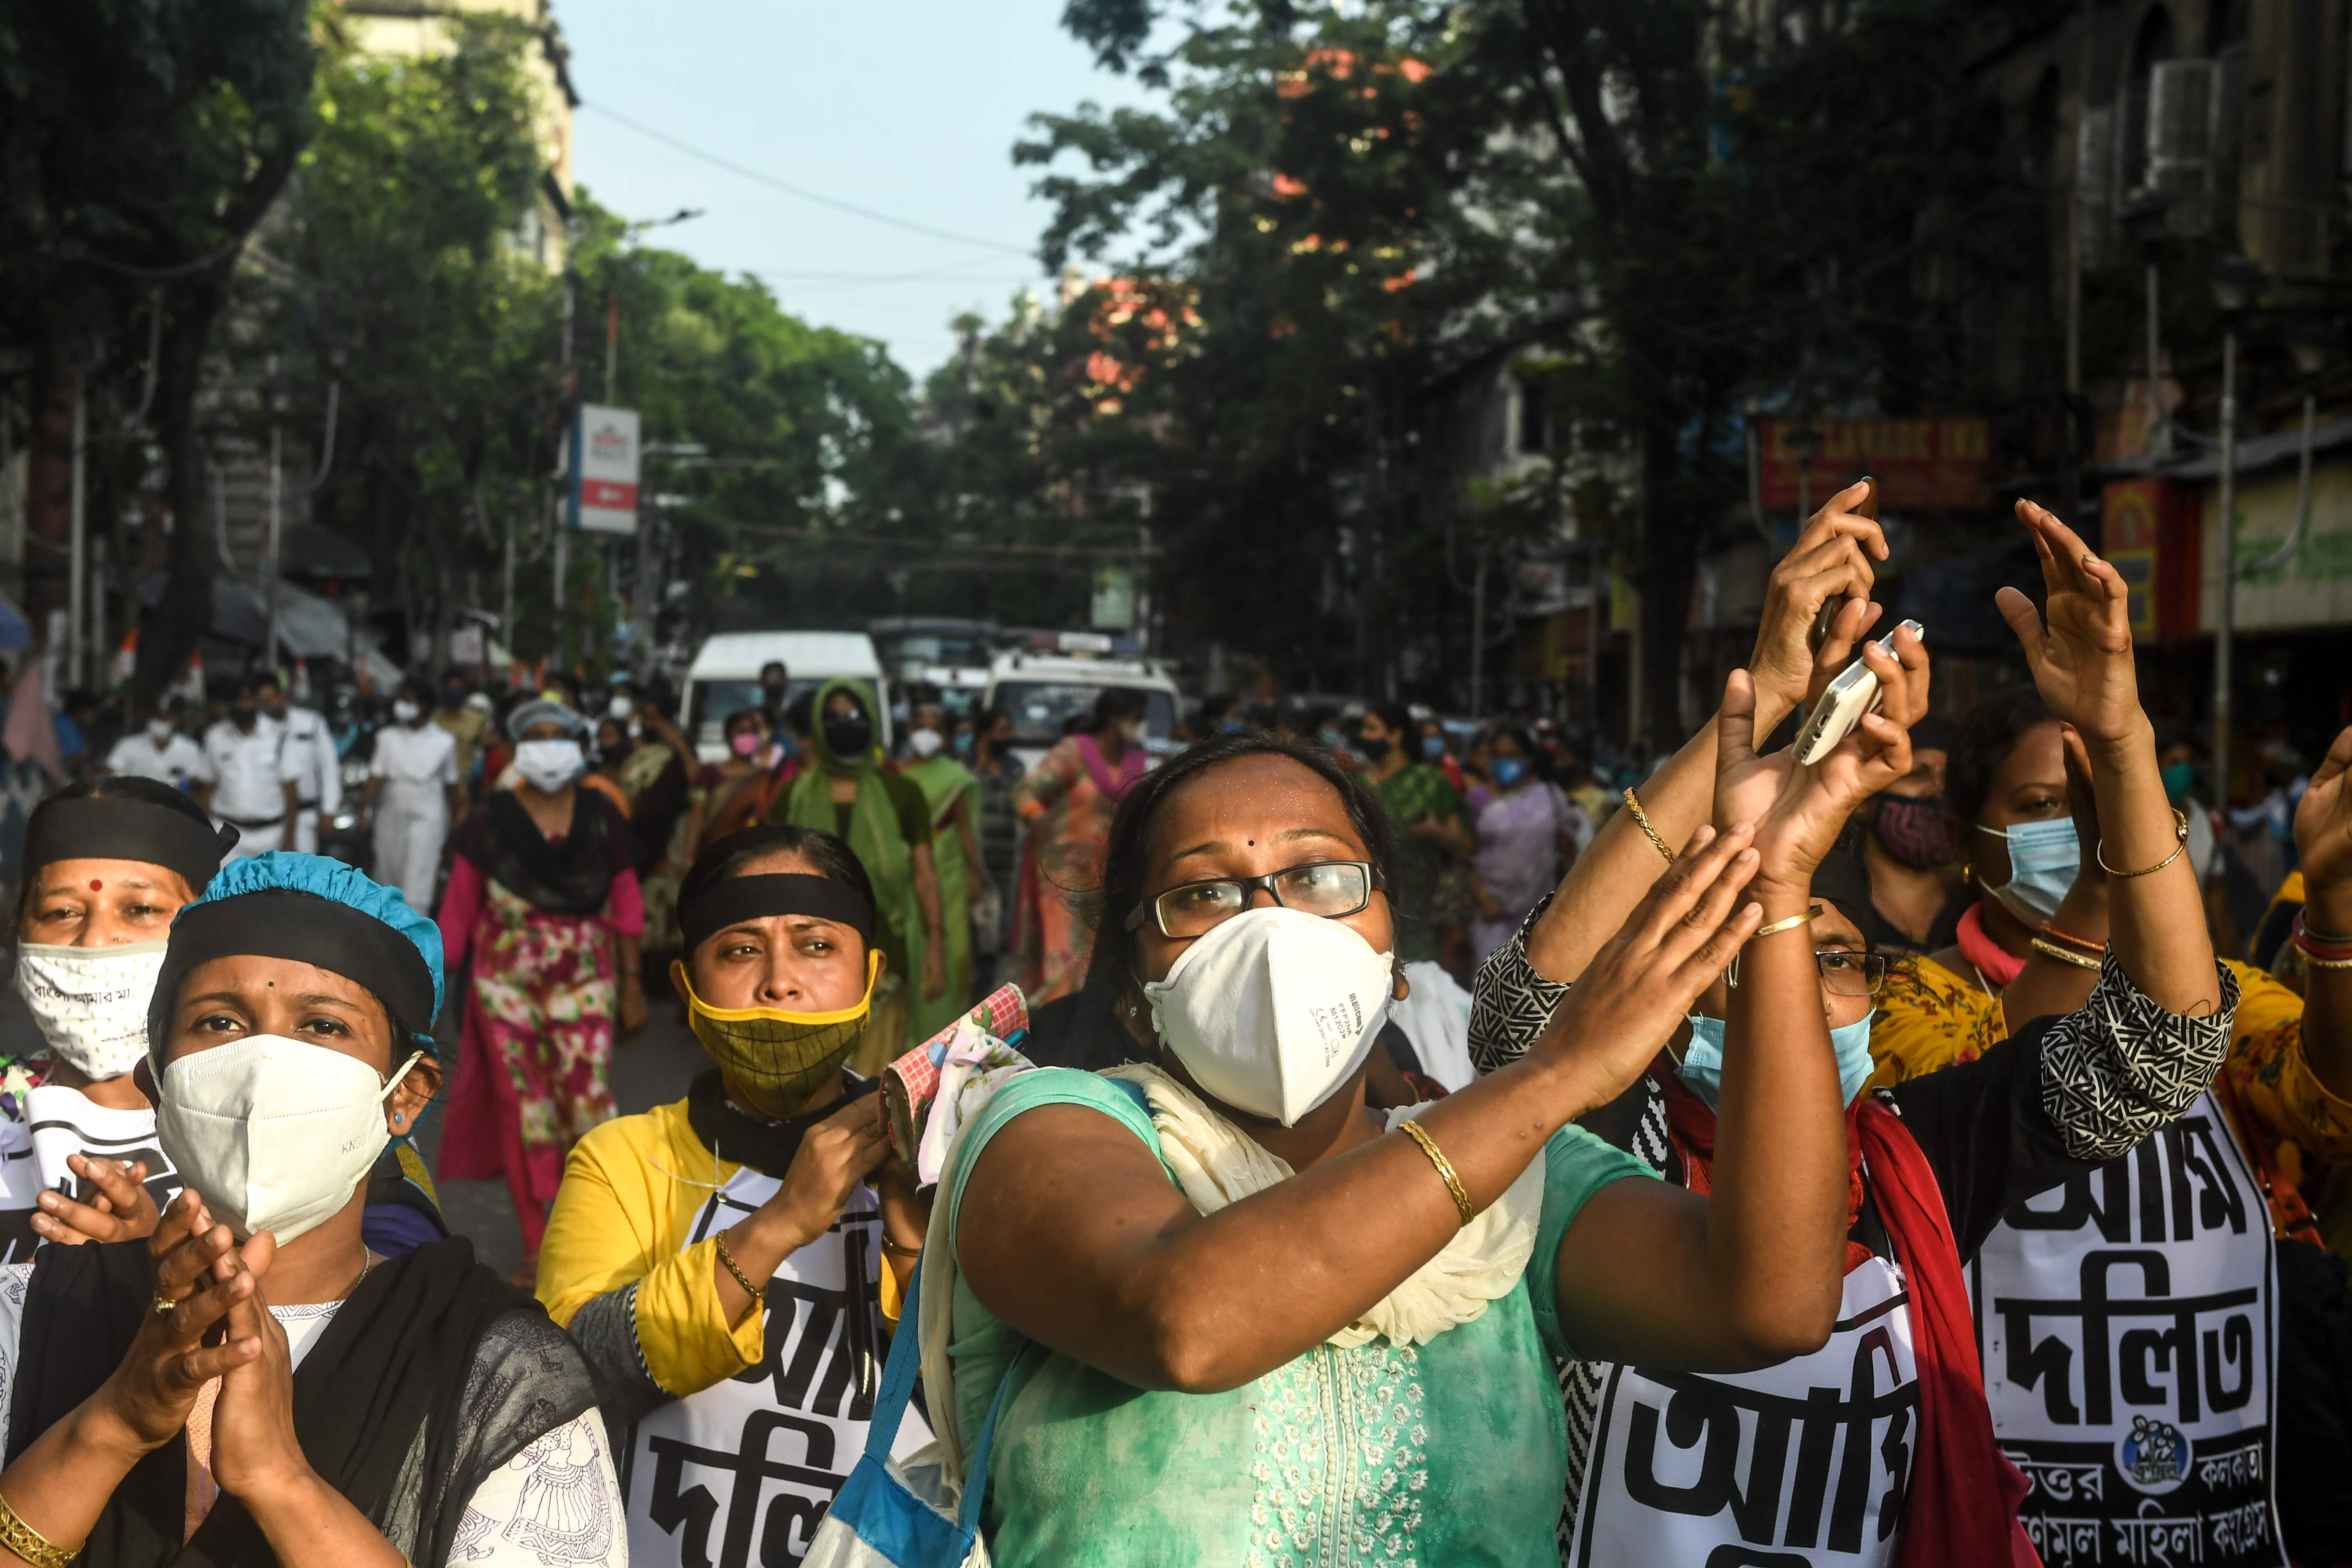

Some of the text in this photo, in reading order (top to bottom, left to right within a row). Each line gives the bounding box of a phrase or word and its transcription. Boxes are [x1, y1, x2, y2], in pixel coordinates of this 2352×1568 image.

[74, 992, 112, 1005] আমার
[115, 989, 130, 999] মা
[1349, 993, 1362, 1028] mallcom
[1994, 1249, 2257, 1426] দলিত
[649, 1409, 848, 1568] দলি
[2196, 1440, 2264, 1493] কলকাতা
[2017, 1498, 2270, 1568] ণমূল মহিলা কংগ্রেস
